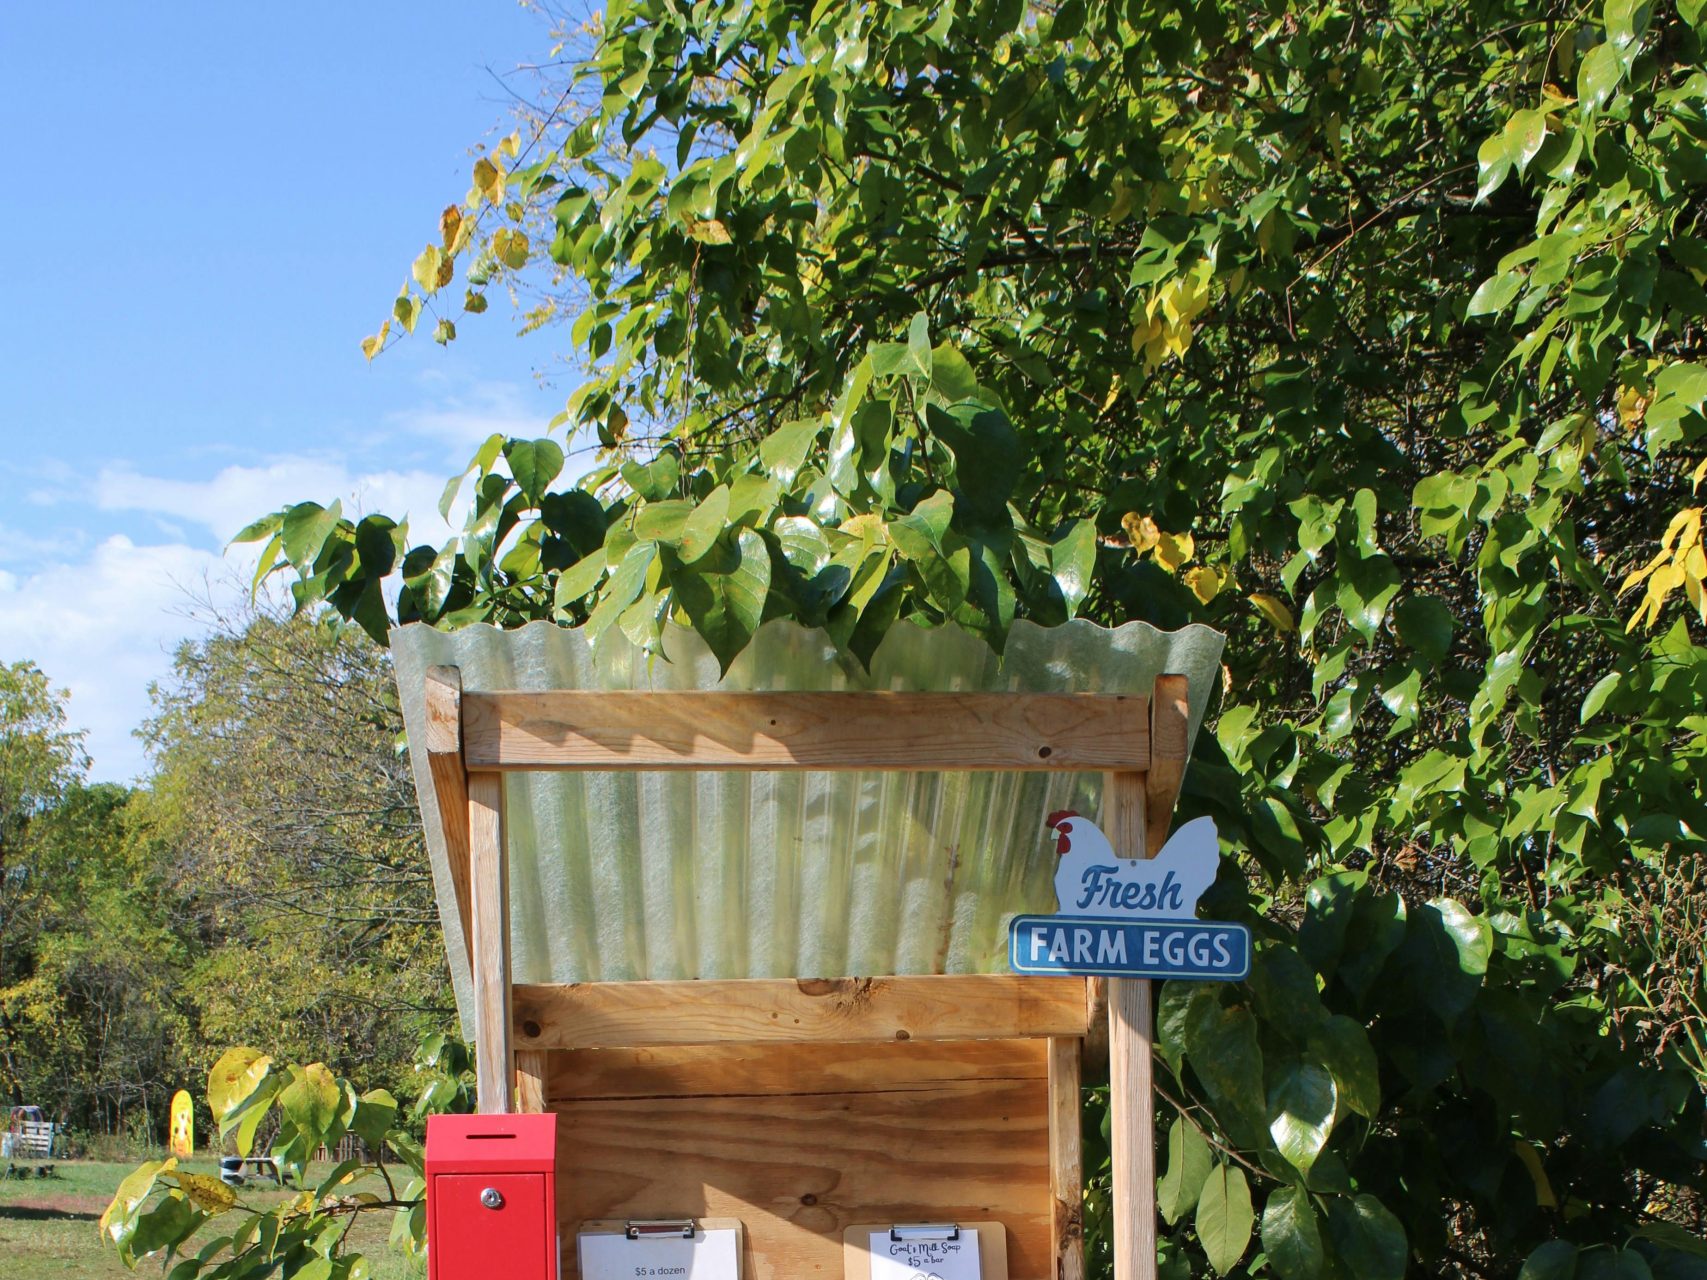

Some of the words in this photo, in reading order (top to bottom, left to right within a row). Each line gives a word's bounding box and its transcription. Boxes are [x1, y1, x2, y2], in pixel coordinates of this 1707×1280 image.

[1076, 864, 1183, 910] Fresh
[1030, 927, 1128, 965] FARM
[1143, 930, 1231, 968] EGGS
[918, 1242, 940, 1258] Milk
[941, 1241, 961, 1254] Soap
[907, 1255, 921, 1268] $5
[931, 1255, 944, 1264] bar
[634, 1267, 647, 1276] $5
[657, 1267, 686, 1275] dozen
